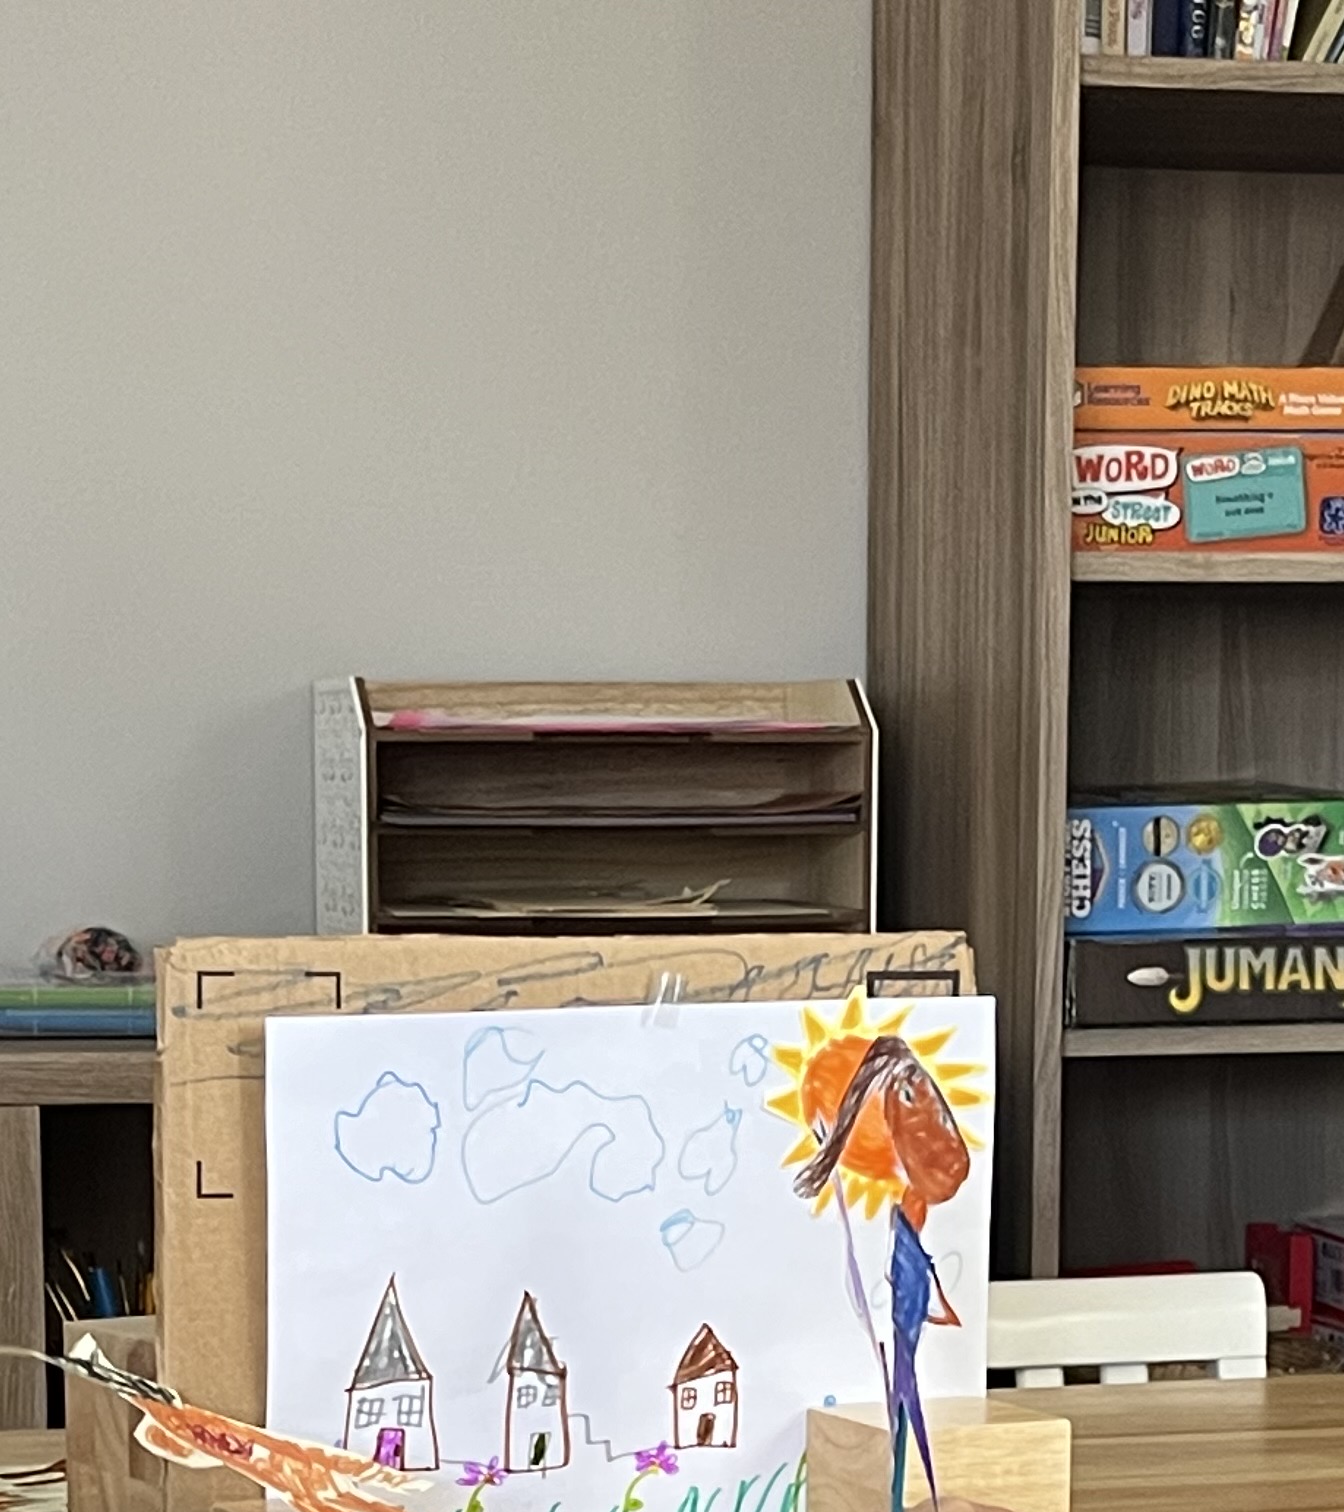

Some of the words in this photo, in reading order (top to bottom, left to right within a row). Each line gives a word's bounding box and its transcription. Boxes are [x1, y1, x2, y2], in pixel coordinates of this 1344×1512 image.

[1165, 381, 1215, 409] DINO
[1222, 380, 1276, 408] MATH
[1190, 400, 1255, 418] TRACKS
[1075, 450, 1170, 483] WORD
[1191, 461, 1237, 478] WORD
[1084, 524, 1154, 545] JUNIOR
[1071, 818, 1092, 919] CHESS
